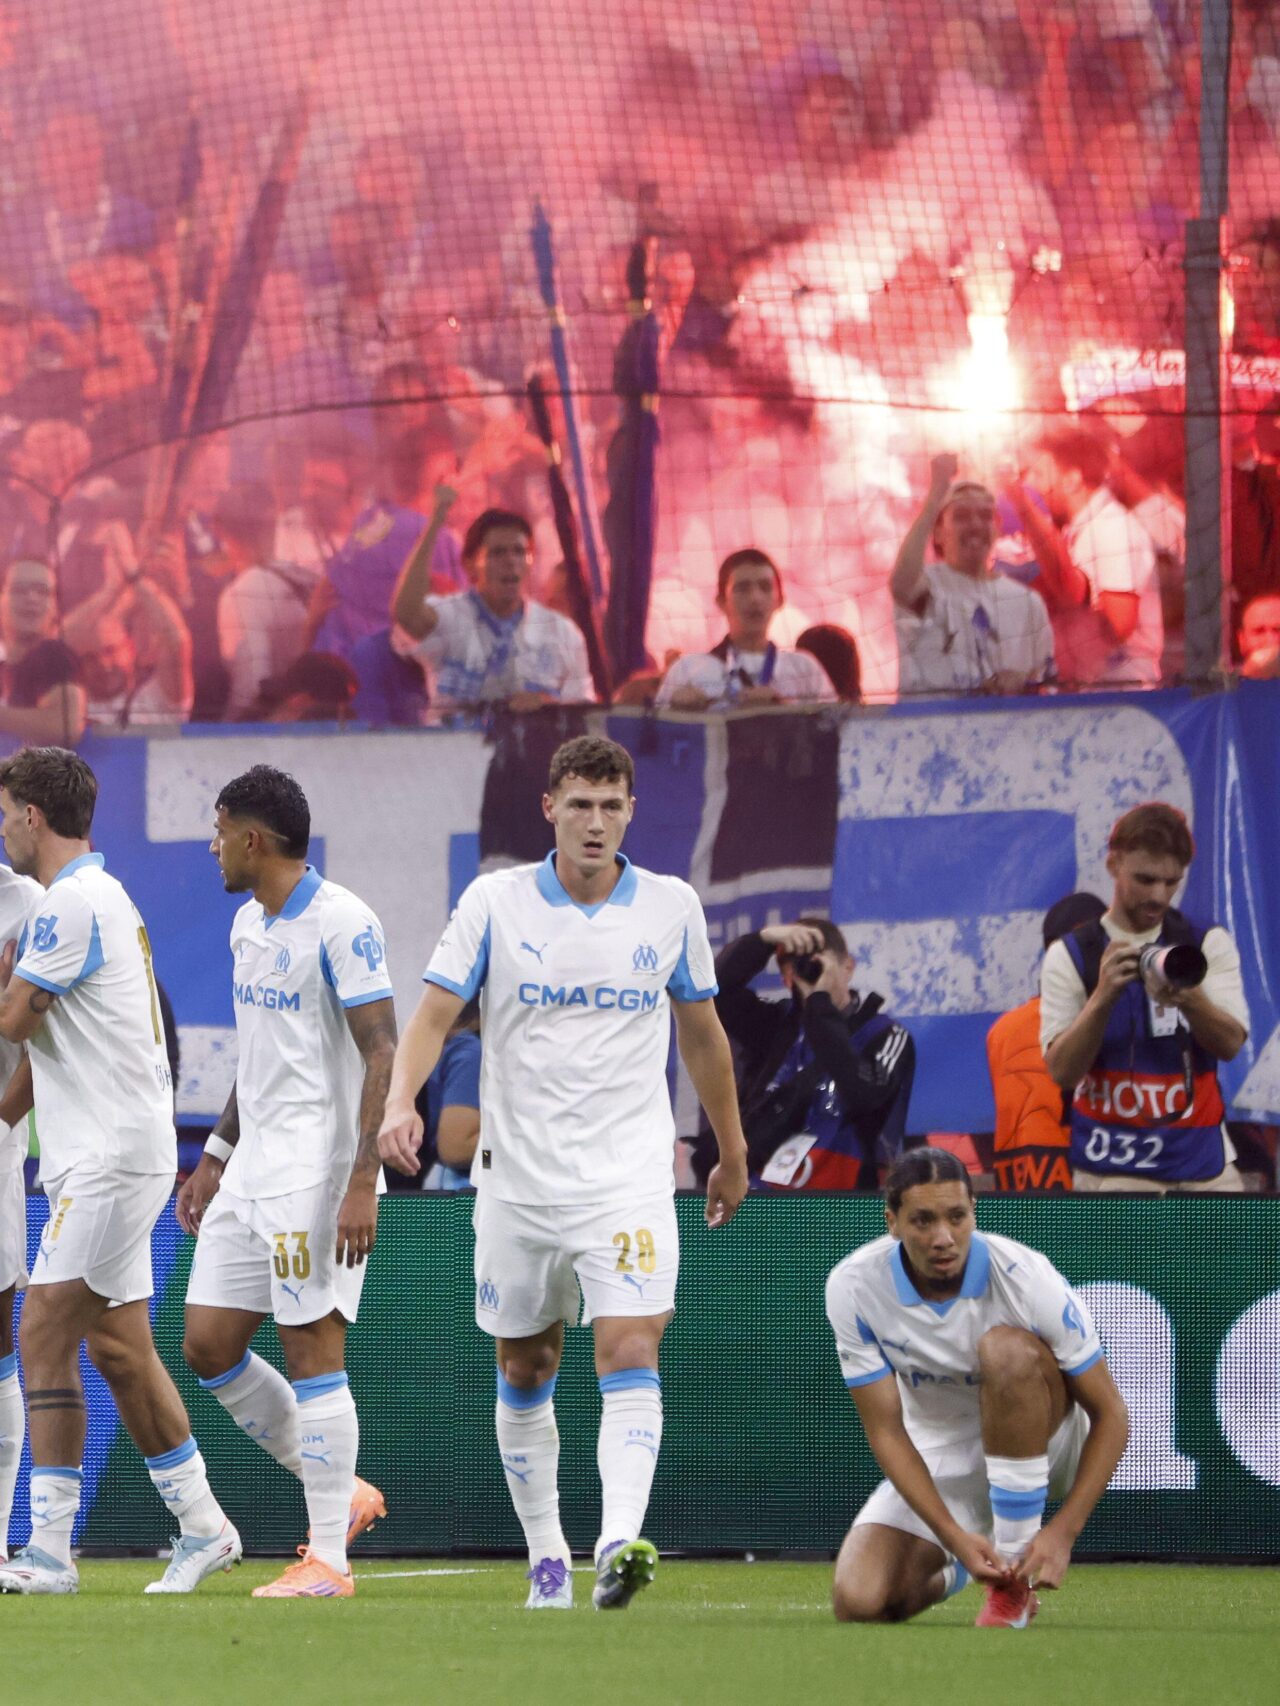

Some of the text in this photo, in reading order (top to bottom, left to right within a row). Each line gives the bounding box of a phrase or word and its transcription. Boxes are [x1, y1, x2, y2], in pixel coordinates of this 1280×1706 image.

[233, 982, 256, 1006] MA
[518, 982, 660, 1012] CMA CGM
[1084, 1126, 1165, 1169] 032
[273, 1230, 311, 1281] 33
[302, 1434, 325, 1445] OM
